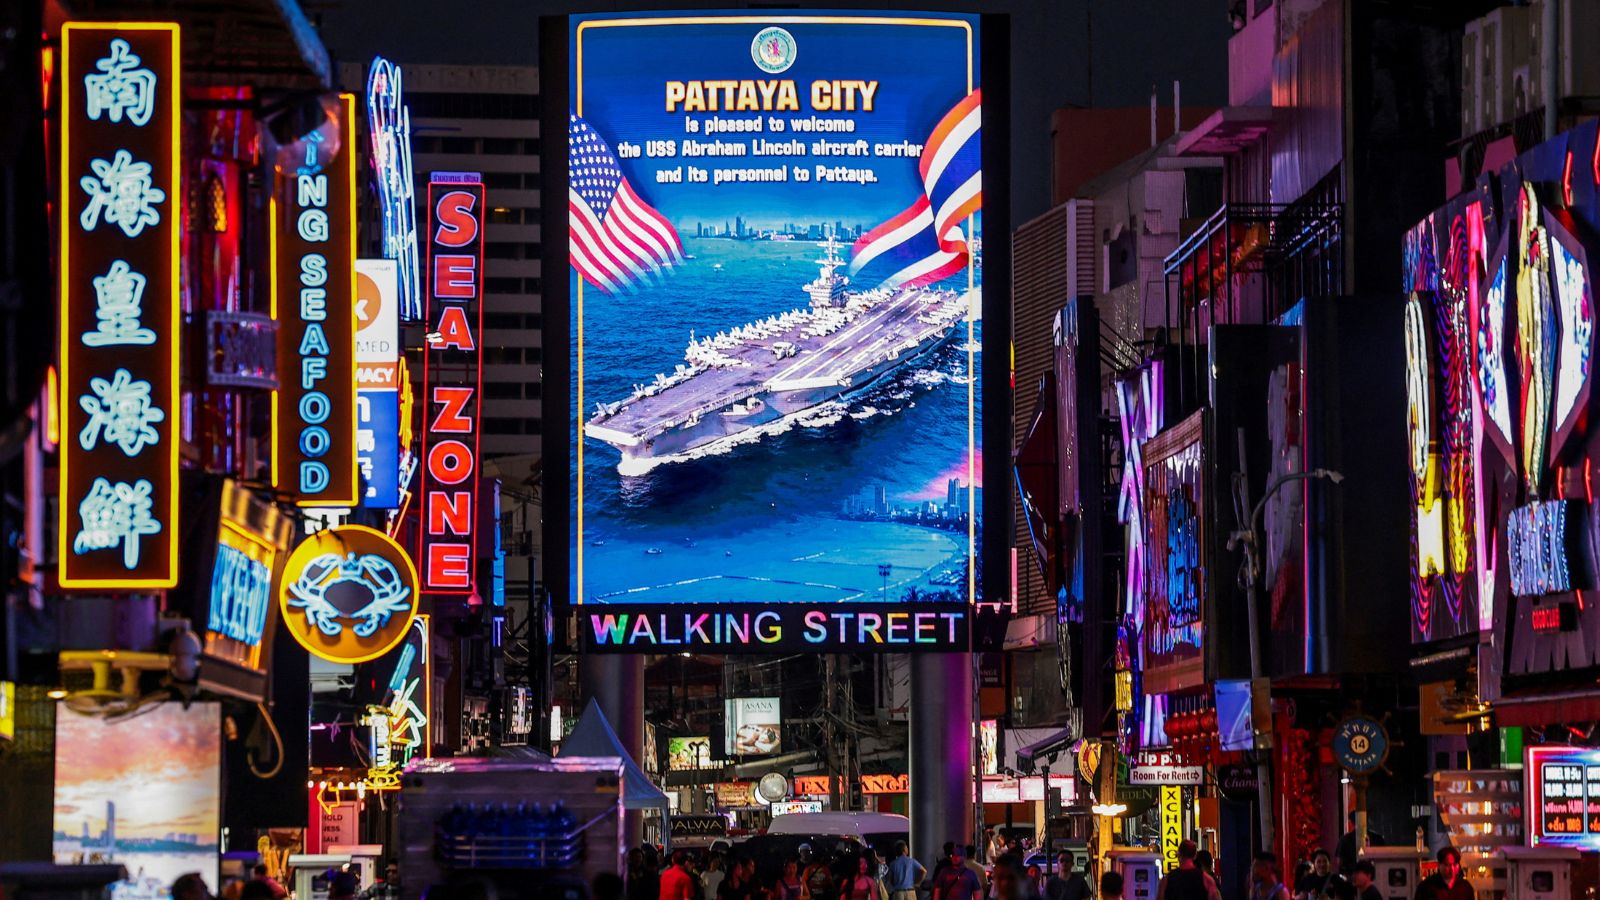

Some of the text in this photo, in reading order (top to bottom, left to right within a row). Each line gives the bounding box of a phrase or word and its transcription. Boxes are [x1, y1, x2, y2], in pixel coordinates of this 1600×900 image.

[665, 79, 878, 112] PATTAYA CITY
[704, 115, 763, 136] pleased
[769, 116, 785, 132] to
[790, 115, 855, 133] welcome
[617, 138, 924, 158] the USS Abraham Lincoln aircraft carrier
[656, 165, 878, 186] and its personnel to Pattaya.
[74, 38, 166, 570] 南海皇海鮮
[297, 130, 331, 494] ING SEAFOOD
[427, 190, 478, 588] SEA ZONE
[590, 610, 964, 645] WALKING STREET
[744, 700, 774, 710] ASANA
[1353, 738, 1366, 750] 14
[1344, 753, 1377, 766] PATTAYA
[801, 779, 909, 793] EXANGE
[1132, 771, 1190, 781] Room For Rent
[1165, 784, 1179, 872] XCHANGE
